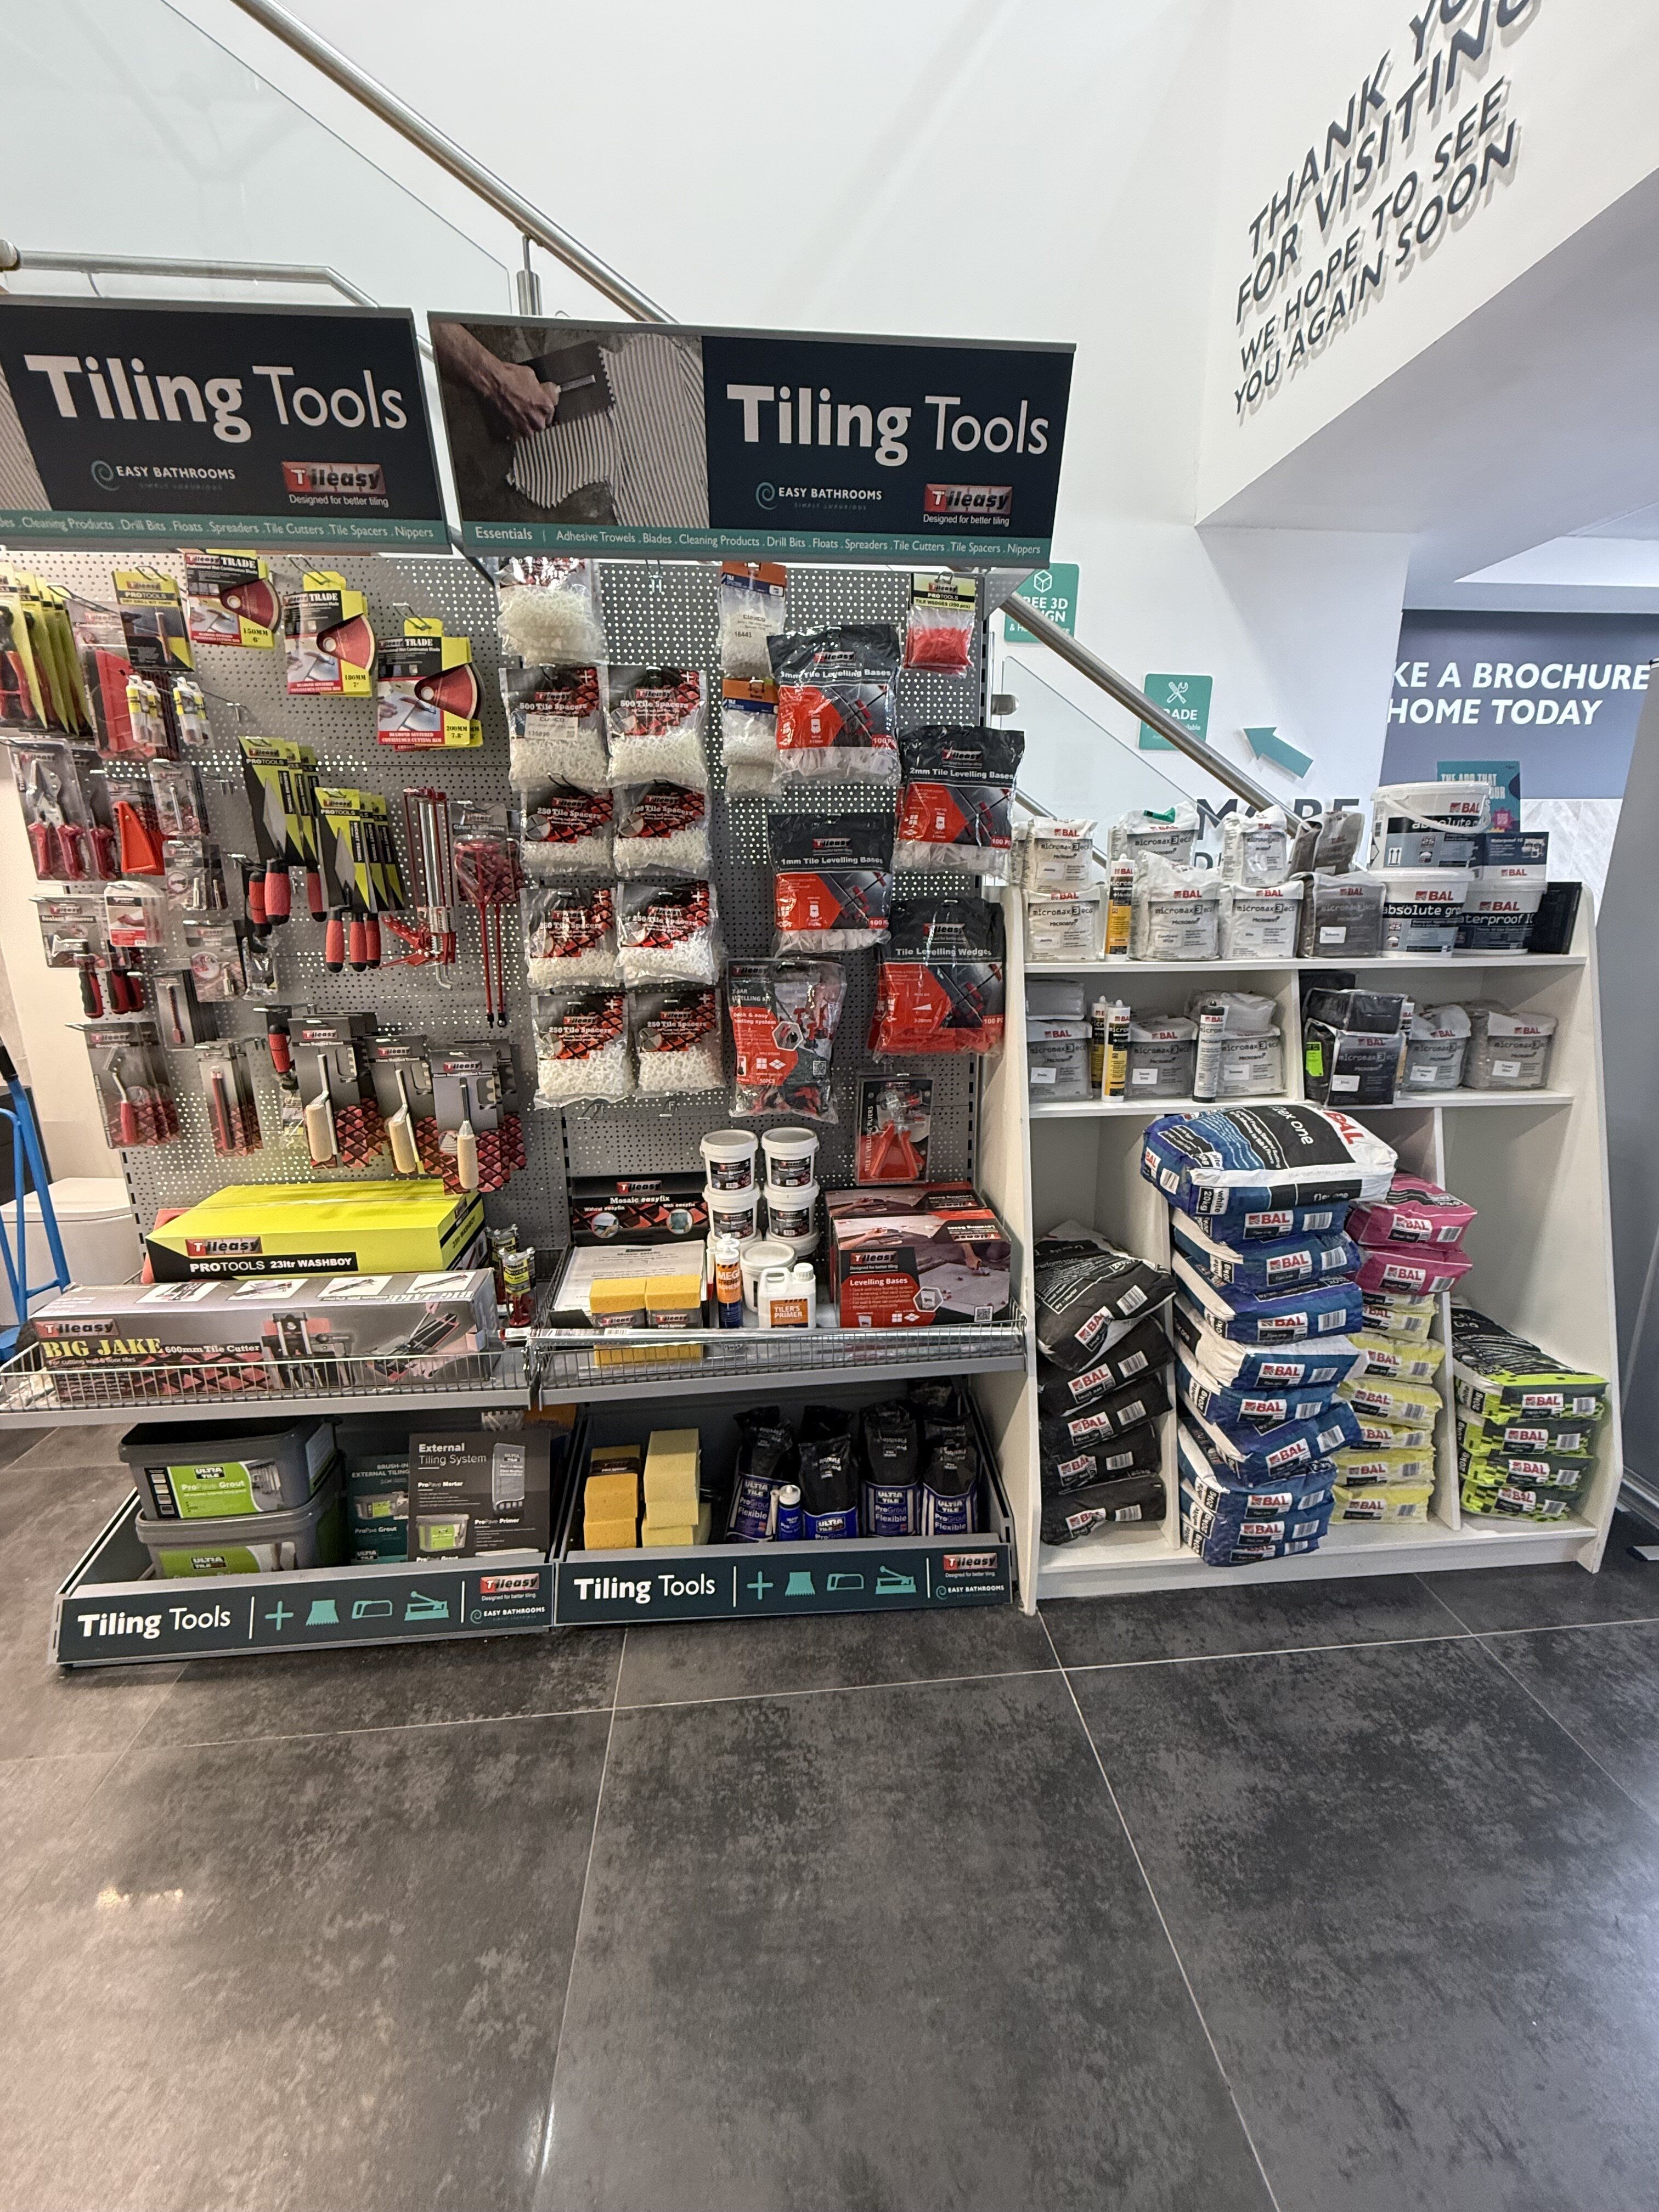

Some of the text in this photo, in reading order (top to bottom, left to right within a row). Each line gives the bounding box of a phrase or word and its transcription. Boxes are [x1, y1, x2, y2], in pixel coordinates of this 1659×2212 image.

[1249, 49, 1391, 259] THANK
[1236, 0, 1529, 326] FOR VISITIN
[1240, 75, 1505, 372] WE HOPE TO SEE
[1234, 119, 1516, 414] YOU AGAIN SOON
[24, 354, 408, 443] Tiling Tools
[727, 384, 1050, 467] Tiling Tools
[116, 465, 235, 480] EASY BATHROOMS
[295, 468, 380, 490] Tileasy
[778, 487, 882, 500] EASY BATHROOMS
[932, 490, 1009, 510] Tileasy
[290, 494, 389, 507] Designed for better tiling
[923, 514, 1009, 527] Designed for better tiling
[22, 517, 67, 532] Cleaning
[69, 518, 114, 530] Products
[121, 520, 144, 530] Drill
[146, 521, 165, 531] Bits
[173, 521, 203, 532] Floats
[209, 521, 259, 535] Spreaders
[264, 522, 284, 534] Tile
[286, 523, 324, 535] Cutters
[329, 524, 348, 535] Tile
[351, 524, 388, 539] Spacers
[395, 526, 434, 539] Nippers
[476, 527, 1041, 556] Essentials Adhesive Trowels Blades Cleaning Products Drill Bits Floats Spreaders Tile Cutters Tile Spacers Nippers
[221, 557, 256, 568] TRADE
[309, 592, 338, 601] TRADE
[1051, 598, 1068, 610] 3D
[1393, 662, 1650, 690] KE A BROCHURE
[655, 701, 689, 709] Spacers
[1387, 698, 1602, 725] HOME TODAY
[950, 770, 986, 778] Levelling
[569, 810, 601, 819] Spacers
[821, 856, 858, 865] Levelling
[1428, 891, 1454, 900] BAL
[1383, 905, 1442, 915] absolute
[1492, 901, 1520, 911] BAL
[1464, 914, 1523, 925] aterproof
[678, 1021, 707, 1029] Spacers
[1053, 1030, 1071, 1039] BAL
[1291, 1120, 1314, 1145] one
[1323, 1111, 1365, 1144] BAL
[1262, 1214, 1290, 1224] BAL
[194, 1241, 259, 1252] Tileasy
[190, 1258, 352, 1272] PROTOOLS 23ltr WASHBOY
[43, 1323, 114, 1334] Tileasy
[41, 1340, 89, 1357] BIG
[98, 1339, 164, 1355] JAKE
[1274, 1365, 1300, 1376] BAL
[1536, 1396, 1561, 1406] BAL
[419, 1443, 465, 1453] External
[419, 1454, 487, 1466] Tiling System
[1258, 1496, 1288, 1506] BAL
[738, 1506, 767, 1519] Flexible
[876, 1514, 907, 1522] Flexible
[487, 1576, 538, 1589] Tileasy
[573, 1573, 715, 1602] Tiling Tools
[503, 1606, 545, 1615] BATHROOMS
[77, 1605, 230, 1640] Tiling Tools
